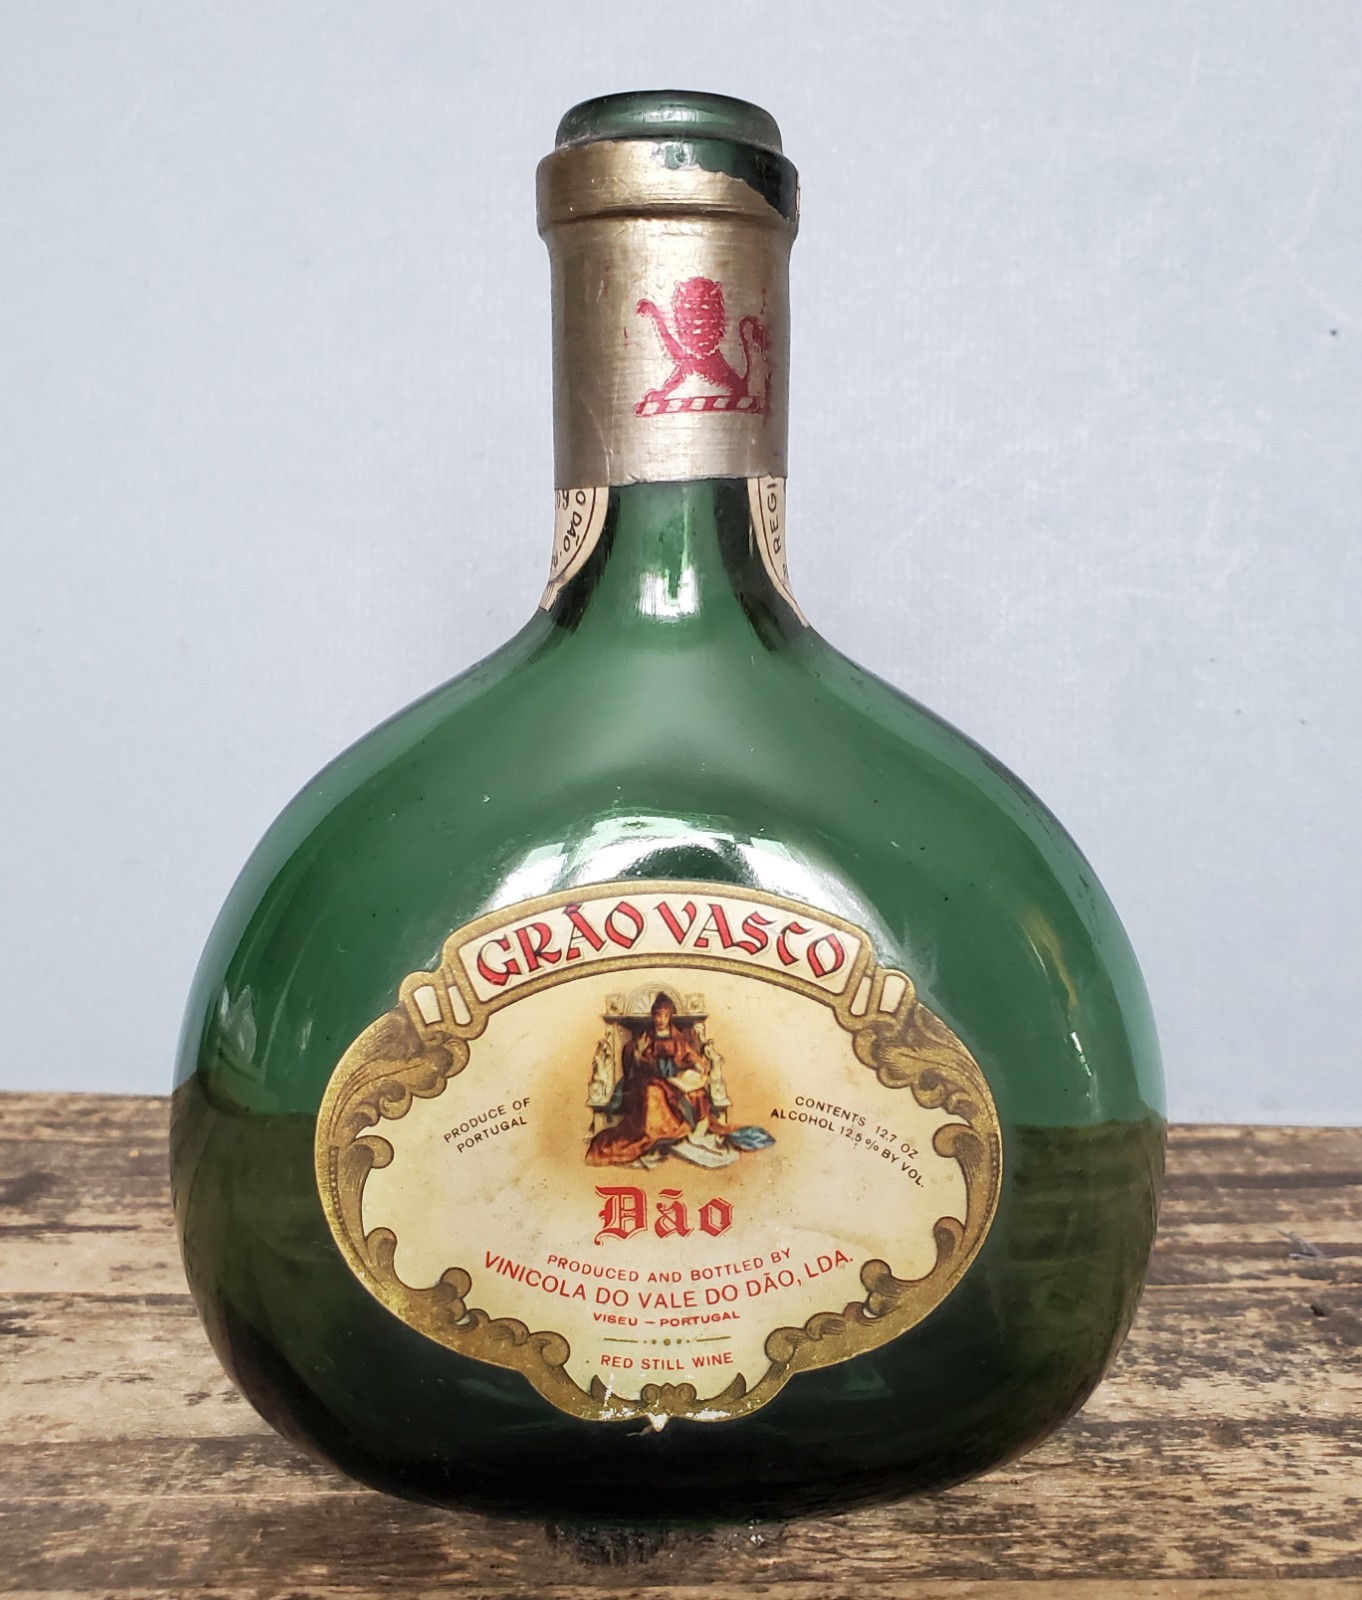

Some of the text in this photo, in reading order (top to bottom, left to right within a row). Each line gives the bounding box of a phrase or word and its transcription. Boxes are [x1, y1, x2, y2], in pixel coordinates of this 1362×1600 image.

[476, 900, 846, 987] GRÃO VASCO
[443, 1097, 531, 1144] PRODUCE OF
[456, 1116, 528, 1154] PORTUGAL
[795, 1096, 867, 1127] CONTENTS
[900, 1143, 919, 1160] OZ
[770, 1108, 835, 1132] ALCOHOL
[881, 1148, 900, 1163] BY
[901, 1161, 925, 1188] VOL.
[593, 1184, 735, 1247] Dão
[484, 1249, 854, 1309] VINICOLA DO VALE DO DÃO, LDA.
[547, 1247, 791, 1283] PRODUCED AND BOTTLED BY
[592, 1312, 639, 1327] VISEU
[659, 1310, 741, 1327] PORTUGAL
[600, 1352, 734, 1370] RED STILL WINE
